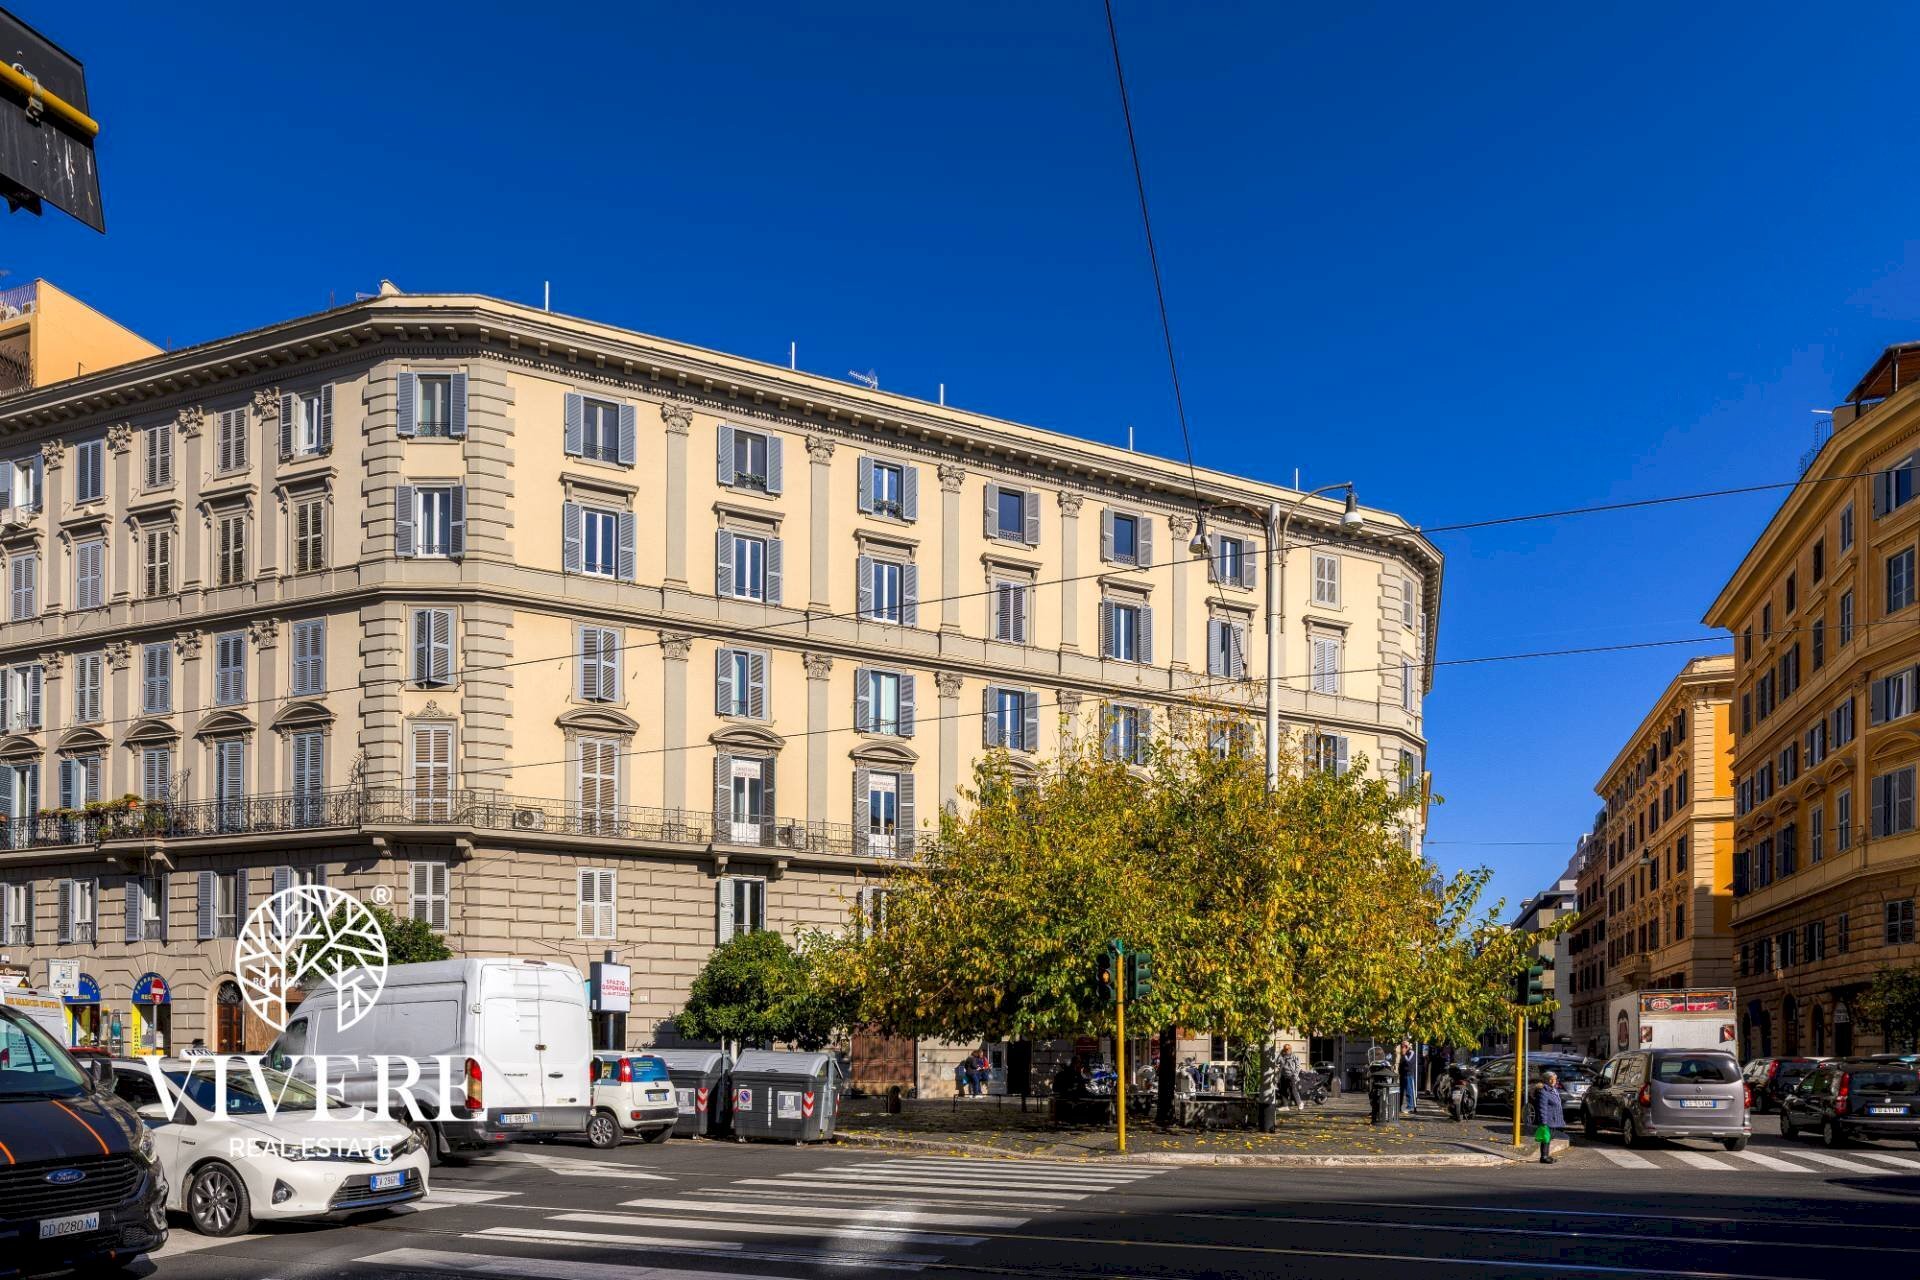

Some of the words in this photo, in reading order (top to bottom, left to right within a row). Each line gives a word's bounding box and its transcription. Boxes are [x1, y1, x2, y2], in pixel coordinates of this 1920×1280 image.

[42, 1224, 56, 1236] CD
[58, 1220, 83, 1233] 0280
[86, 1217, 97, 1228] NA
